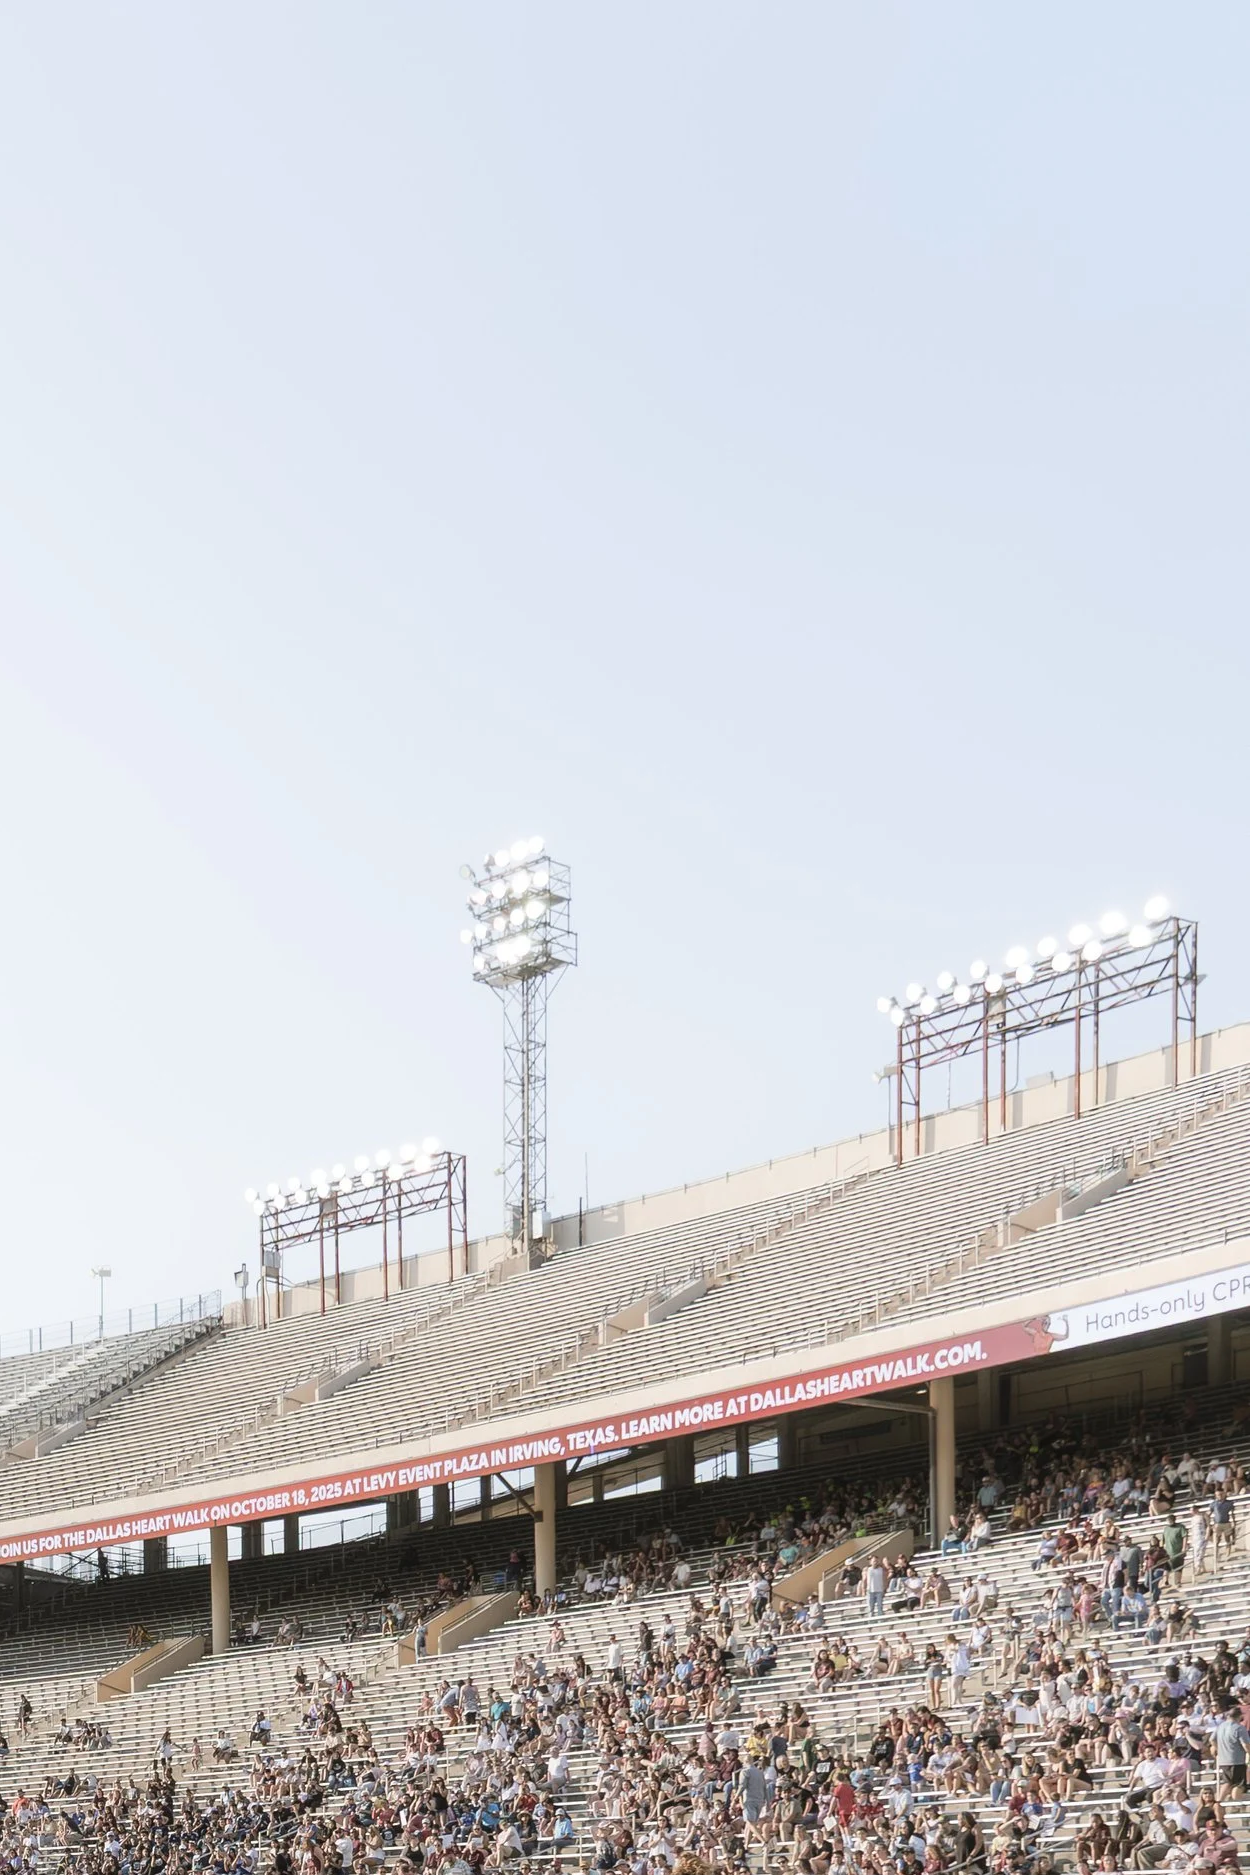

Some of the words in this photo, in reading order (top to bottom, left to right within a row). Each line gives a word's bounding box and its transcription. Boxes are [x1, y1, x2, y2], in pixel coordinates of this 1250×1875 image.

[1086, 1290, 1205, 1333] Hands-only
[1212, 1276, 1250, 1301] CPR
[23, 1538, 38, 1555] US
[39, 1535, 62, 1552] FOR
[63, 1531, 85, 1548] THE
[86, 1521, 131, 1544] DALLAS
[132, 1514, 171, 1536] HEART
[172, 1505, 209, 1527] WALK
[211, 1503, 230, 1521] ON
[231, 1491, 290, 1517] OCTOBER
[292, 1489, 310, 1507] 18,
[311, 1483, 343, 1502] 2025
[343, 1479, 362, 1497] AT
[363, 1471, 397, 1492] LEVY
[398, 1461, 443, 1486] EVENT
[444, 1451, 489, 1477] PLAZA
[490, 1449, 508, 1467] IN
[508, 1436, 566, 1464] IRVING,
[567, 1424, 619, 1449] TEXAS.
[621, 1412, 673, 1440] LEARN
[674, 1400, 724, 1428] MORE
[725, 1396, 748, 1418] AT
[749, 1340, 988, 1413] DALLASHEARTWALK.COM.
